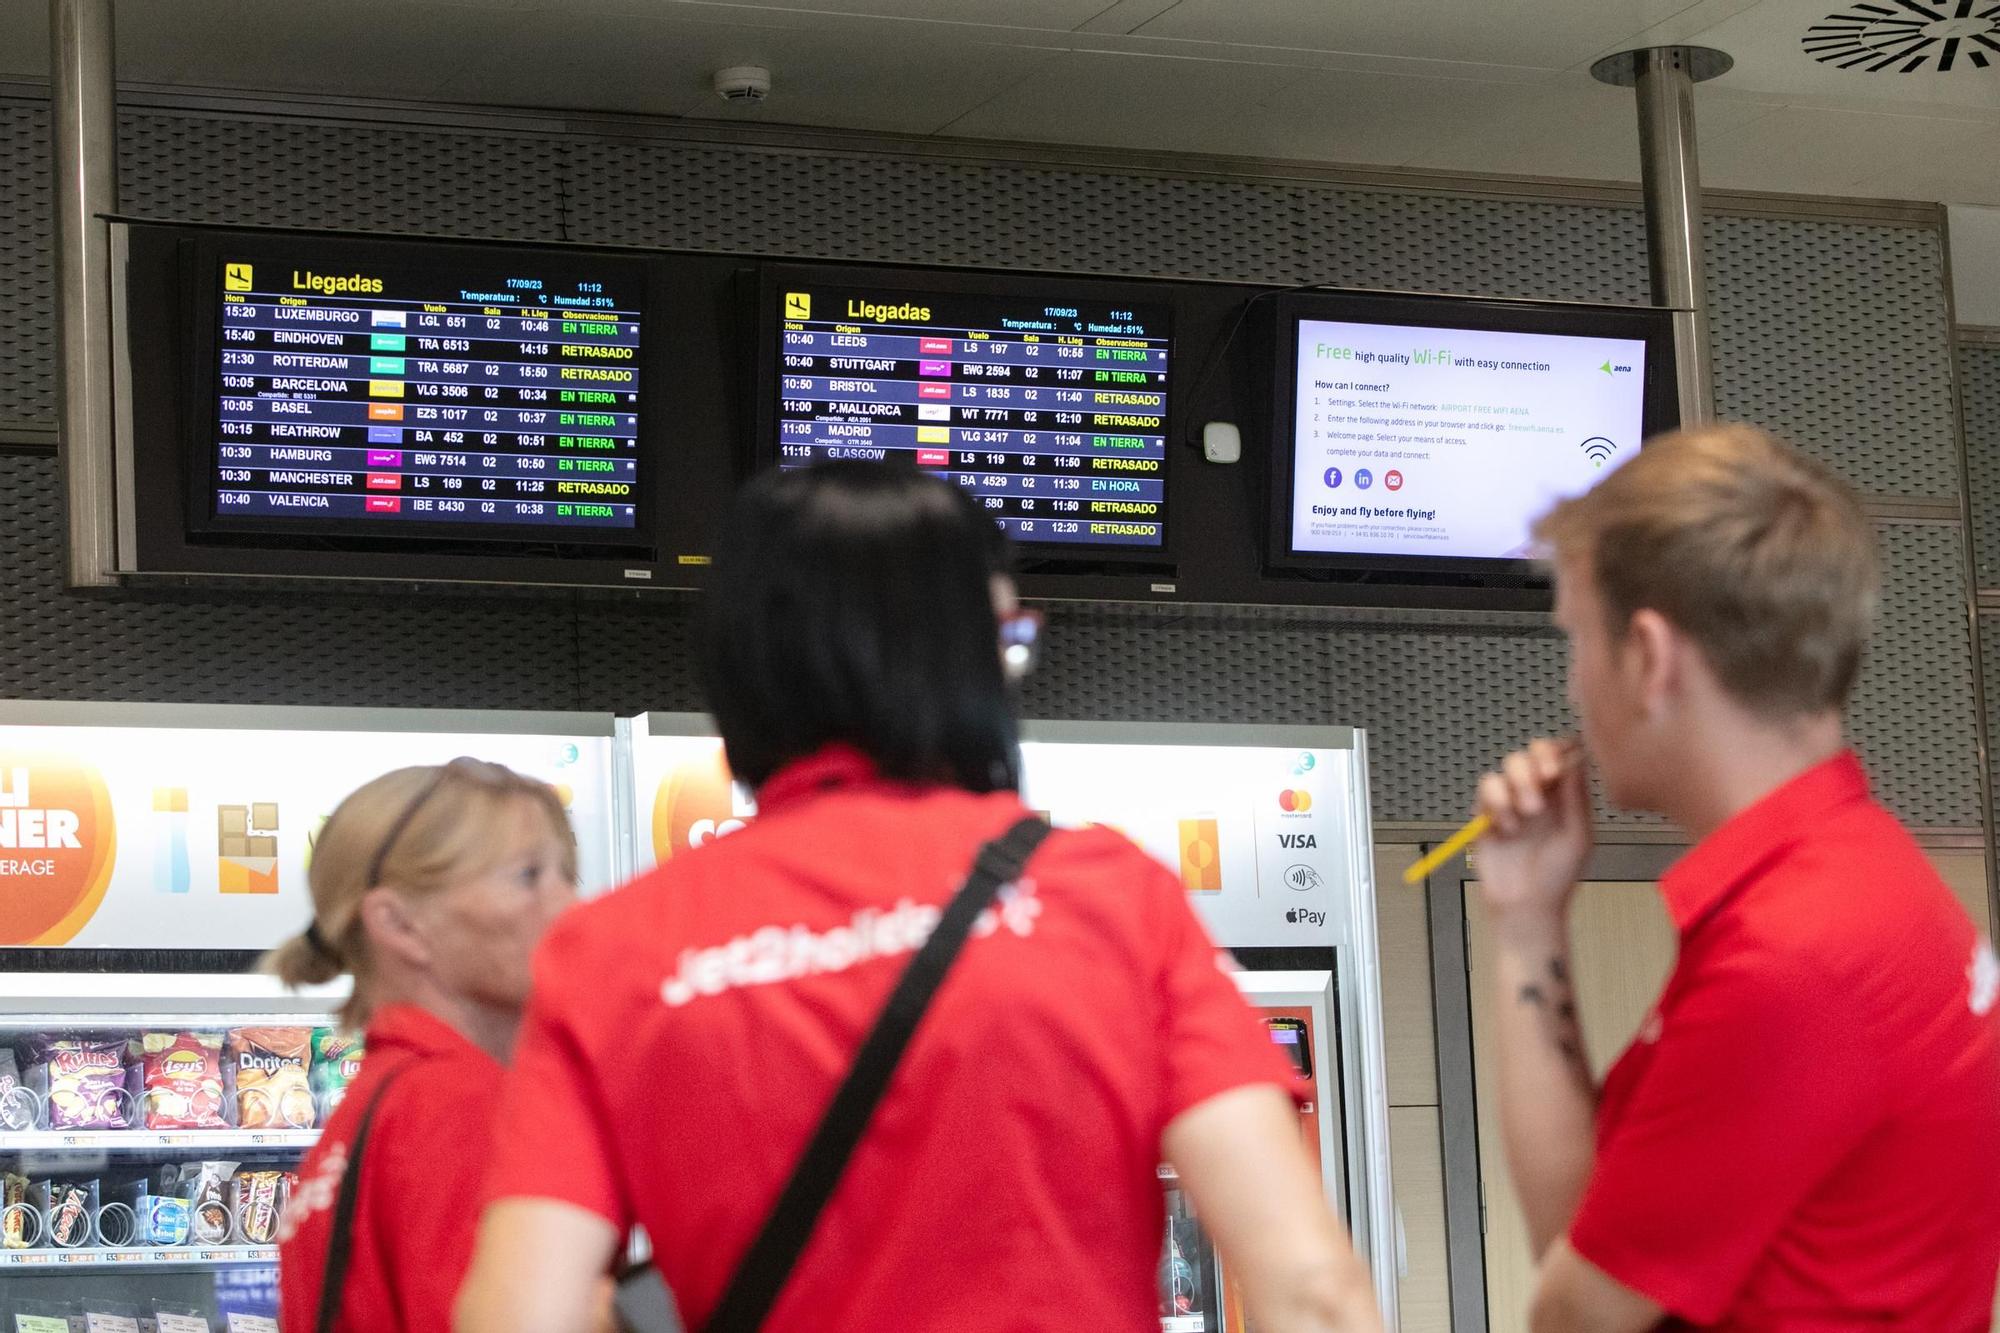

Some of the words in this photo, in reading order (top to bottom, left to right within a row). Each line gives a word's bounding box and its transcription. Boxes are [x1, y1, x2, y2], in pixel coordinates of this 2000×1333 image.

[293, 271, 383, 295] Llegadas
[506, 279, 543, 290] 17/09/23
[578, 283, 602, 293] 11:12
[225, 307, 256, 317] 15:20
[275, 308, 359, 323] LUXEMBURGO
[420, 316, 440, 327] LGL
[447, 317, 466, 328] 651
[487, 319, 500, 329] 02
[563, 323, 576, 334] EN
[580, 323, 618, 335] TIERRA
[848, 300, 930, 322] Llegadas
[224, 330, 255, 341] 15:40
[274, 332, 343, 345] EINDHOVEN
[419, 339, 439, 349] TRA
[443, 339, 470, 351] 6513
[520, 344, 548, 355] 14:15
[562, 346, 633, 359] RETRASADO
[785, 334, 814, 344] 10:40
[831, 335, 867, 347] LEEDS
[964, 342, 978, 353] LS
[990, 344, 1008, 354] 197
[1026, 346, 1039, 356] 02
[1057, 347, 1083, 358] 10:55
[1096, 349, 1109, 359] EN
[1112, 350, 1147, 361] TIERRA
[1316, 343, 1351, 359] Free
[1355, 352, 1375, 363] high
[1378, 353, 1410, 365] quality
[1413, 349, 1452, 365] Wi-Fi
[1455, 358, 1474, 367] with
[1477, 359, 1498, 369] easy
[1501, 360, 1550, 371] connection
[223, 353, 255, 364] 21:30
[273, 355, 348, 369] ROTTERDAM
[418, 362, 438, 373] TRA
[442, 362, 469, 374] 5687
[485, 365, 499, 375] 02
[519, 367, 548, 378] 15:50
[561, 369, 632, 382] RETRASADO
[785, 357, 813, 367] 10:40
[830, 358, 896, 371] STUTTGART
[963, 365, 983, 375] EWG
[986, 366, 1010, 376] 2594
[1025, 368, 1038, 378] 02
[1057, 369, 1083, 380] 11:07
[1095, 371, 1108, 381] EN
[1111, 372, 1147, 383] TIERRA
[223, 376, 254, 387] 10:05
[272, 378, 347, 392] BARCELONA
[417, 385, 438, 395] VLG
[442, 385, 468, 397] 3506
[485, 388, 498, 398] 02
[519, 389, 547, 401] 10:34
[561, 391, 575, 402] EN
[578, 392, 616, 404] TIERRA
[784, 379, 812, 389] 10:50
[829, 381, 877, 393] BRISTOL
[963, 387, 977, 397] LS
[986, 388, 1010, 398] 1835
[1025, 389, 1037, 400] 02
[1056, 391, 1082, 402] 11:40
[1095, 393, 1160, 405] RETRASADO
[1315, 380, 1332, 389] How
[1335, 382, 1348, 390] can
[1350, 382, 1353, 390] I
[1355, 383, 1390, 392] connect?
[222, 400, 253, 411] 10:05
[272, 402, 312, 414] BASEL
[417, 408, 437, 419] EZS
[441, 409, 467, 420] 1017
[484, 411, 497, 421] 02
[518, 412, 546, 423] 10:37
[560, 414, 574, 425] EN
[577, 414, 615, 426] TIERRA
[783, 401, 812, 412] 11:00
[829, 403, 901, 416] P.MALLORCA
[962, 409, 979, 419] WT
[985, 410, 1009, 421] 7771
[1024, 411, 1037, 422] 02
[1055, 413, 1082, 424] 12:10
[1094, 414, 1159, 427] RETRASADO
[222, 423, 253, 434] 10:15
[271, 425, 340, 438] HEATHROW
[416, 431, 433, 441] BA
[443, 432, 464, 443] 452
[483, 434, 497, 444] 02
[517, 435, 545, 446] 10:51
[559, 437, 573, 448] EN
[577, 437, 615, 449] TIERRA
[783, 424, 811, 434] 11:05
[829, 426, 871, 437] MADRID
[221, 447, 252, 458] 10:30
[271, 449, 332, 461] HAMBURG
[415, 454, 436, 465] EWG
[440, 455, 466, 466] 7514
[483, 457, 496, 467] 02
[517, 458, 545, 469] 10:50
[559, 460, 573, 471] EN
[576, 460, 614, 472] TIERRA
[782, 446, 811, 457] 11:15
[828, 448, 885, 460] GLASGOW
[1327, 448, 1356, 456] complete
[220, 470, 251, 481] 10:30
[270, 472, 353, 485] MANCHESTER
[415, 477, 430, 488] LS
[442, 478, 462, 489] 169
[482, 479, 496, 490] 02
[516, 481, 544, 492] 11:25
[558, 483, 629, 495] RETRASADO
[219, 494, 250, 504] 10:40
[269, 495, 329, 507] VALENCIA
[414, 500, 433, 510] IBE
[438, 500, 465, 512] 8430
[482, 502, 495, 513] 02
[515, 503, 544, 515] 10:38
[557, 505, 571, 516] EN
[575, 506, 613, 517] TIERRA
[1312, 506, 1337, 516] Enjoy
[1340, 507, 1357, 515] and
[1360, 507, 1371, 517] fly
[1374, 508, 1403, 518] before
[1406, 509, 1435, 520] flying!
[1278, 834, 1317, 848] VISA
[1298, 909, 1326, 927] Pay
[240, 1052, 302, 1076] Doritos
